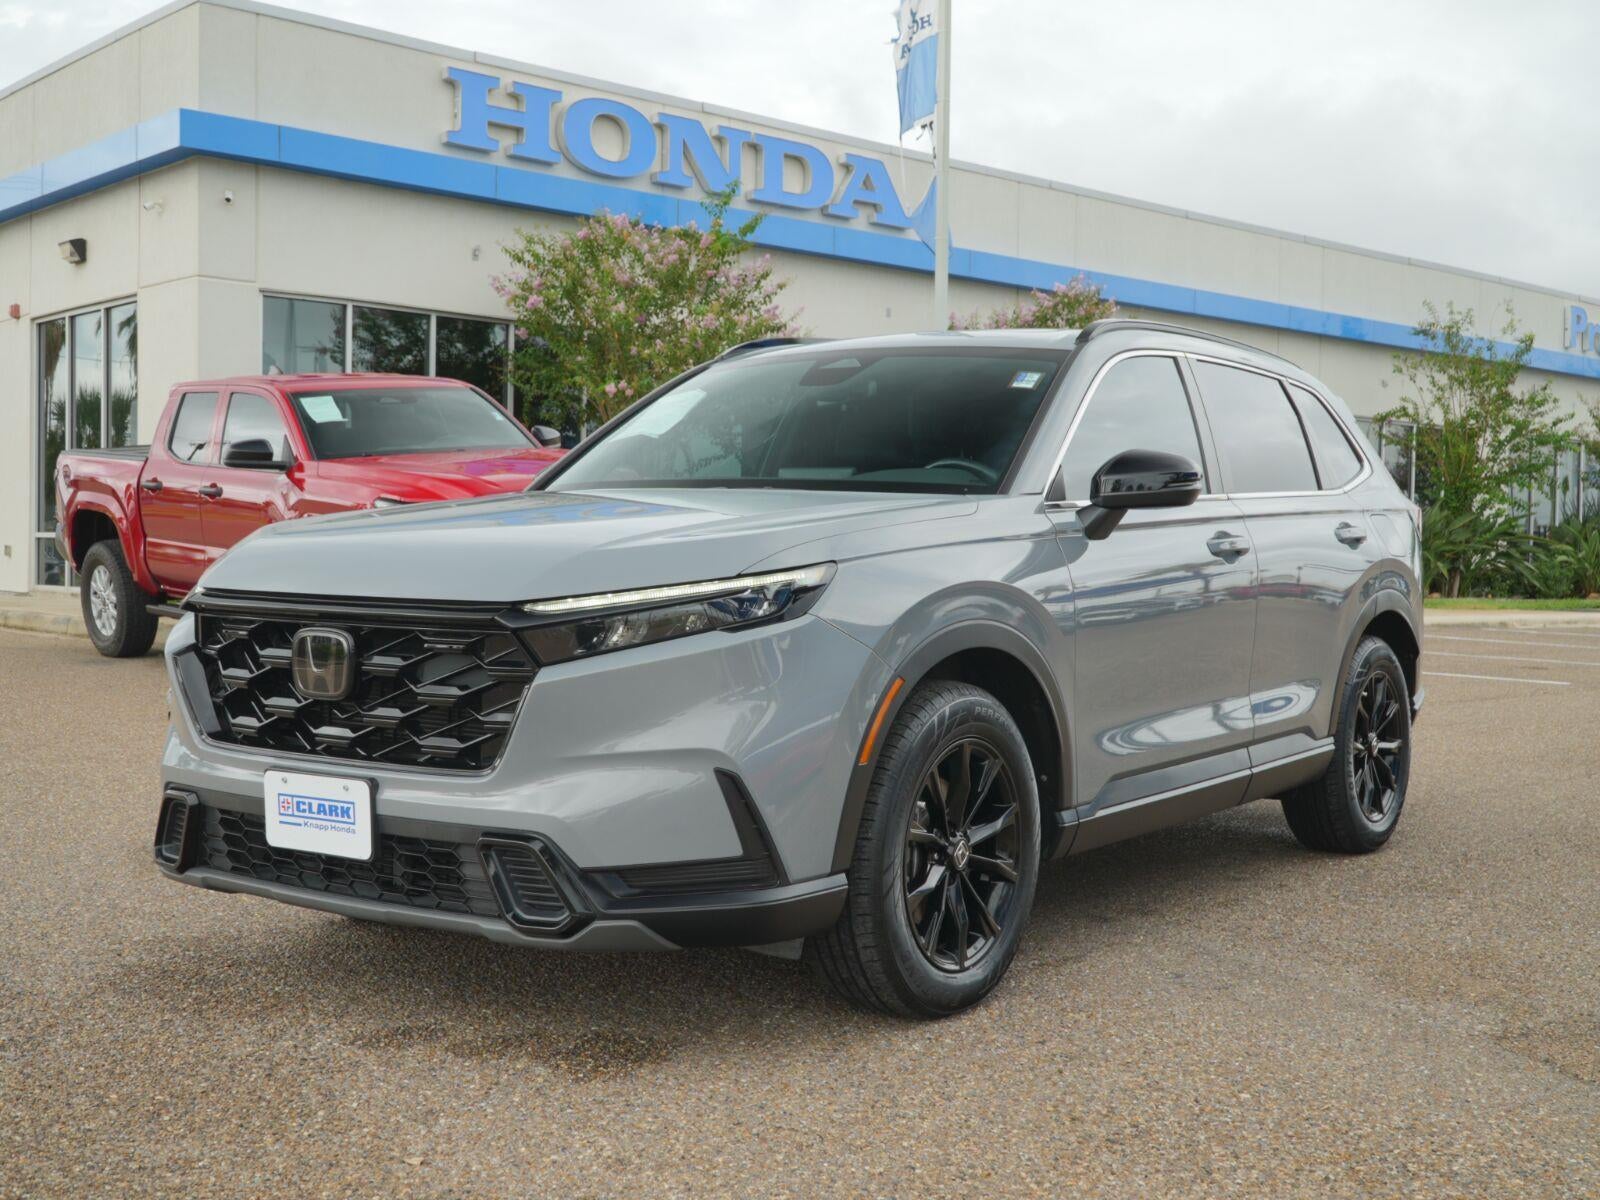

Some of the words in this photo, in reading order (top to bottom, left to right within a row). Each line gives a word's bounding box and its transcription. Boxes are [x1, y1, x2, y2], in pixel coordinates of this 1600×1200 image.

[442, 66, 915, 230] HONDA
[1564, 304, 1600, 357] Pr
[296, 800, 351, 819] CLARK
[303, 821, 330, 831] Knapp
[330, 825, 356, 834] Honda
